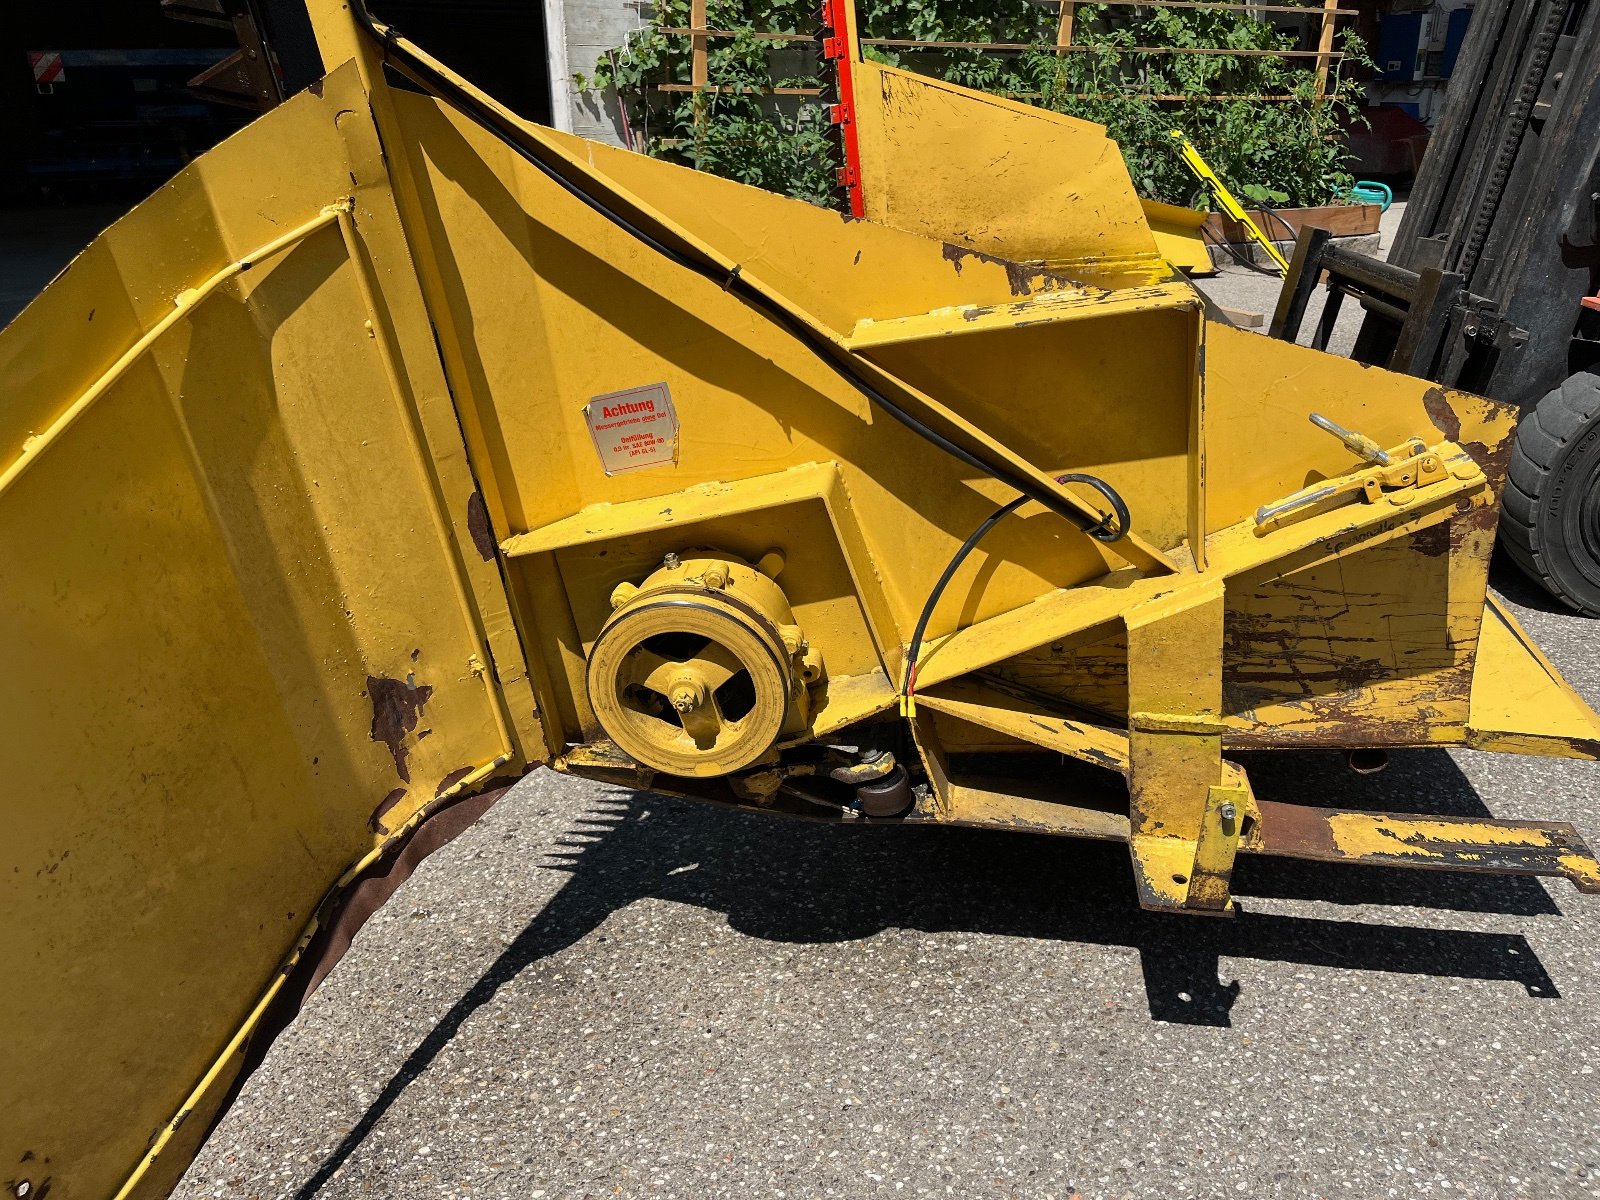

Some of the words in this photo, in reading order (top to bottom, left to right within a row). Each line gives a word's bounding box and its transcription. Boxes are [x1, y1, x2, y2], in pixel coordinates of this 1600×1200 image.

[603, 400, 655, 418] Achtung
[595, 418, 640, 431] Messergetriebe
[642, 414, 656, 423] ohne
[620, 432, 654, 444] Oelfüllung
[629, 449, 641, 458] (API
